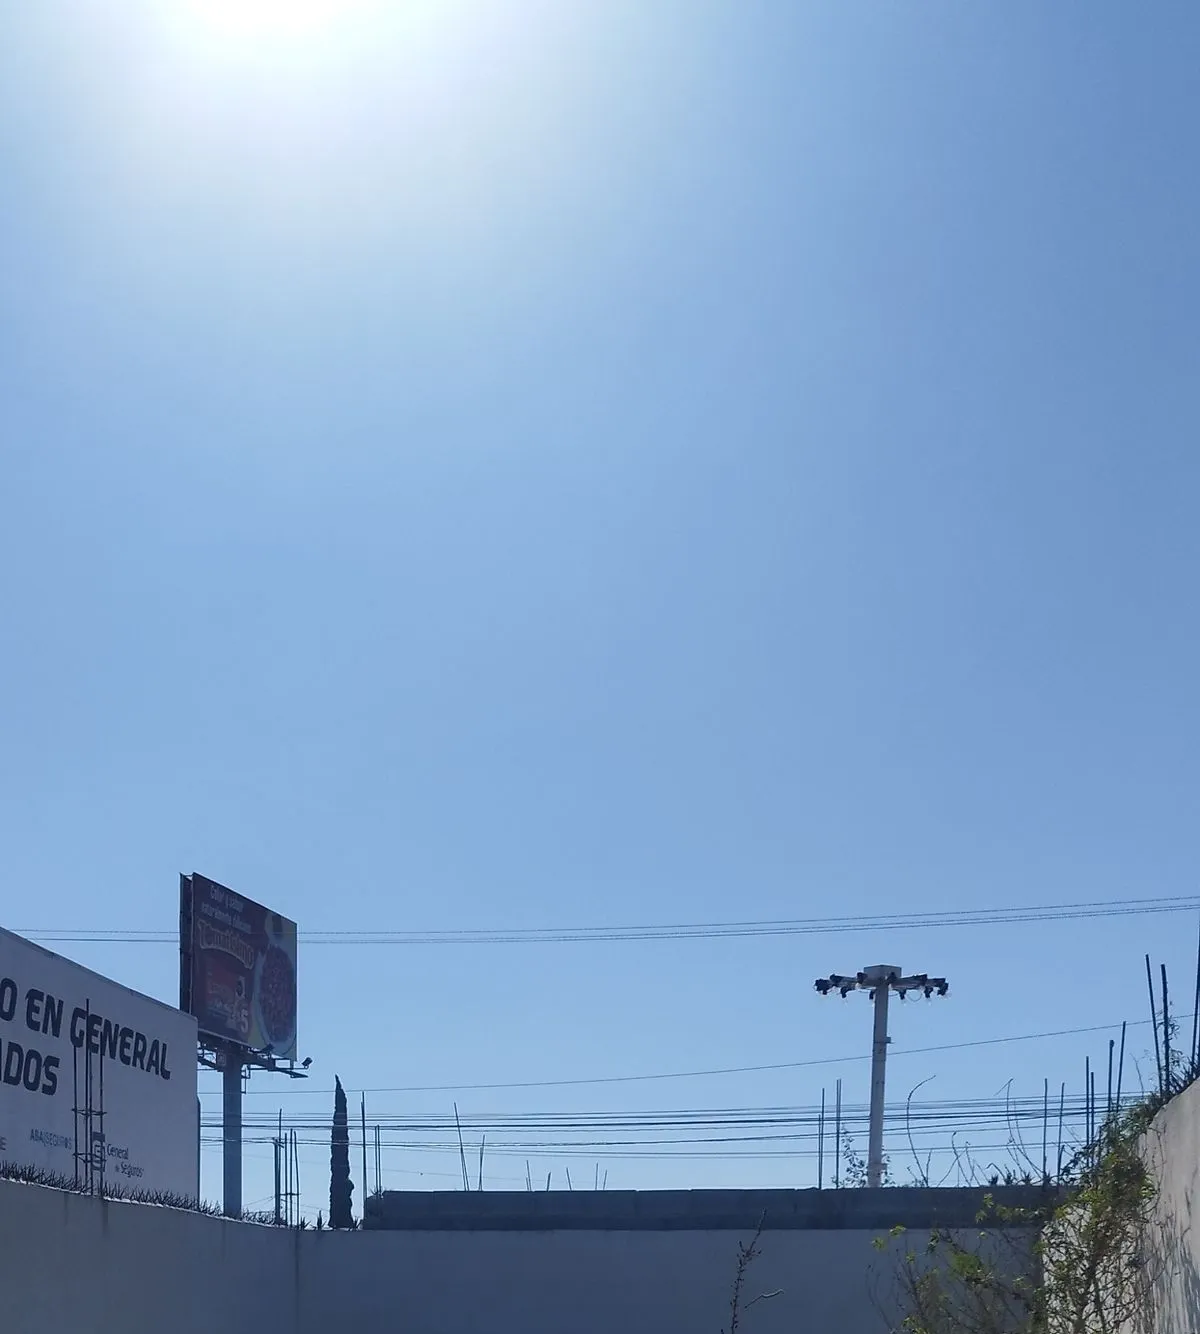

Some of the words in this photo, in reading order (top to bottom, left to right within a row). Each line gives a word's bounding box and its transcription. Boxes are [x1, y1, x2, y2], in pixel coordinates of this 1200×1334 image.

[25, 988, 64, 1038] EN
[70, 1007, 171, 1080] GENERAL
[107, 1144, 129, 1160] General
[121, 1161, 144, 1178] Seguros
